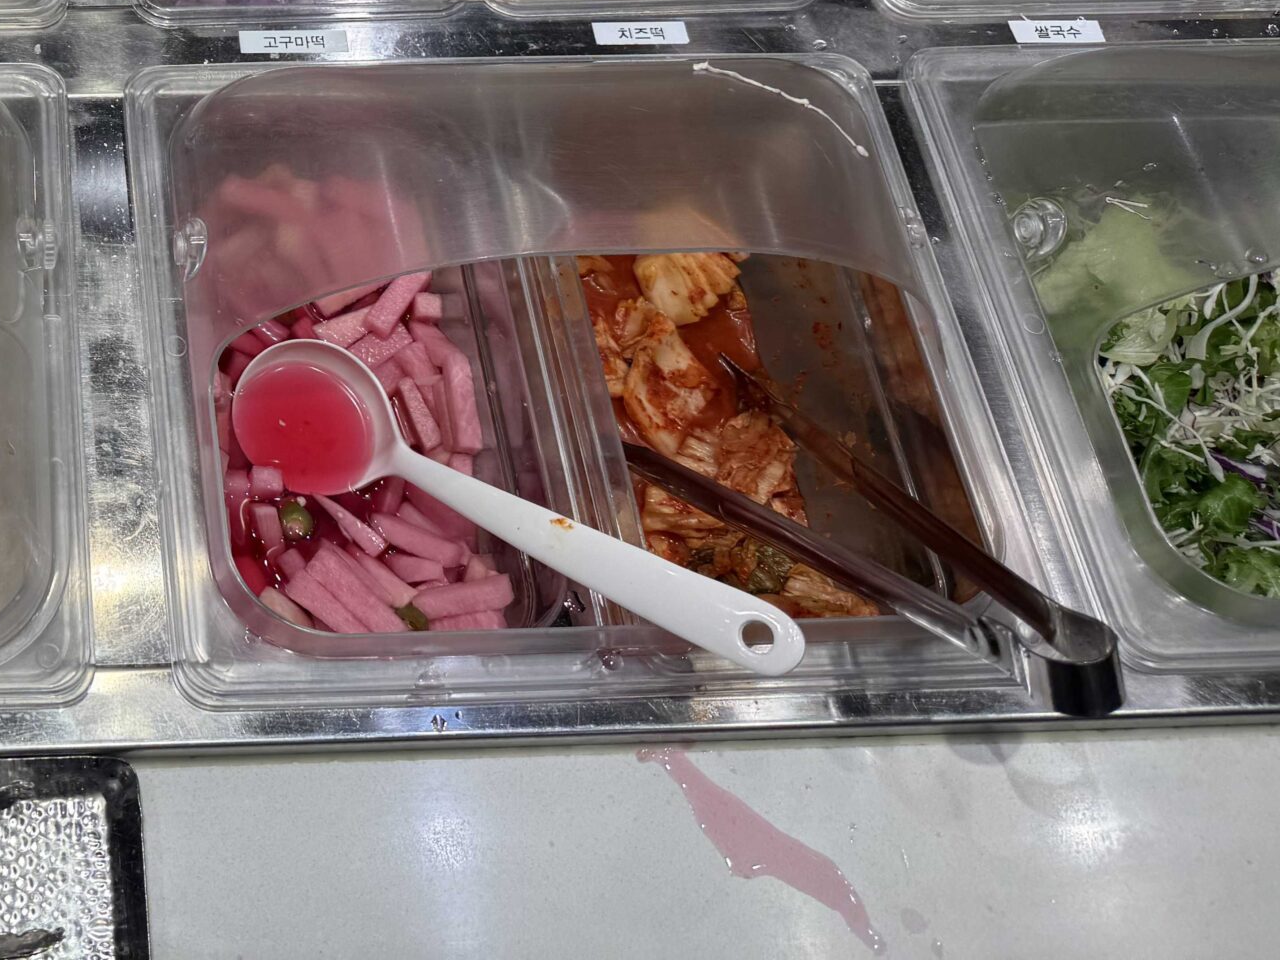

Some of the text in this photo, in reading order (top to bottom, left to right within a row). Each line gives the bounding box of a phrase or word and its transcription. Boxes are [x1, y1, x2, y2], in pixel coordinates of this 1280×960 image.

[617, 26, 666, 40] 치즈떡
[1034, 25, 1082, 39] 쌀국수
[263, 35, 326, 49] 고구마떡
